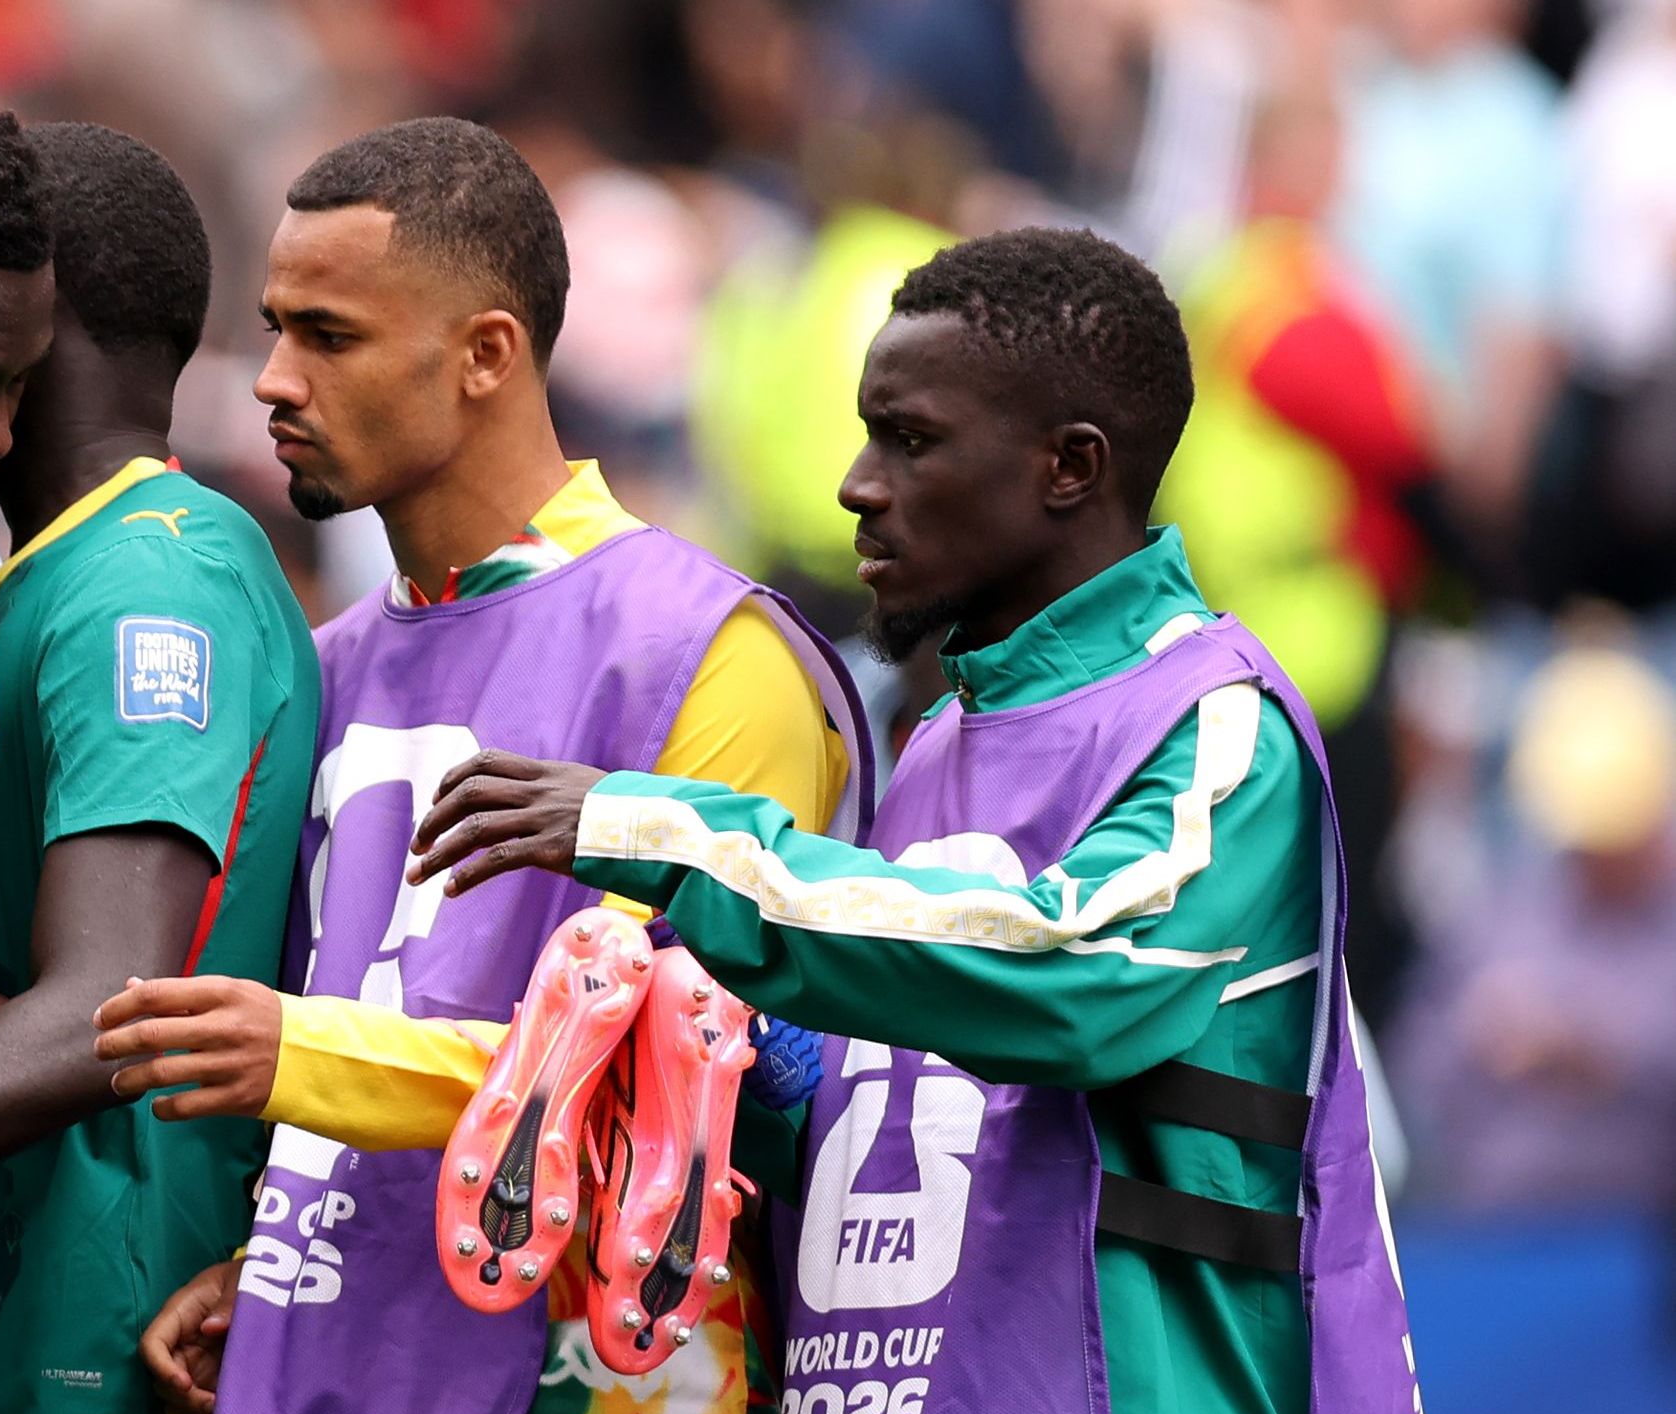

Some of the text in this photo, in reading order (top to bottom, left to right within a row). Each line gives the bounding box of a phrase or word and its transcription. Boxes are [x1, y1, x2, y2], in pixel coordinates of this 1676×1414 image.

[134, 648, 199, 680] UNITES
[135, 631, 199, 658] FOOTBALL
[297, 1190, 357, 1238] CP
[835, 1217, 915, 1266] FIFA
[784, 1327, 944, 1377] WORLD CUP
